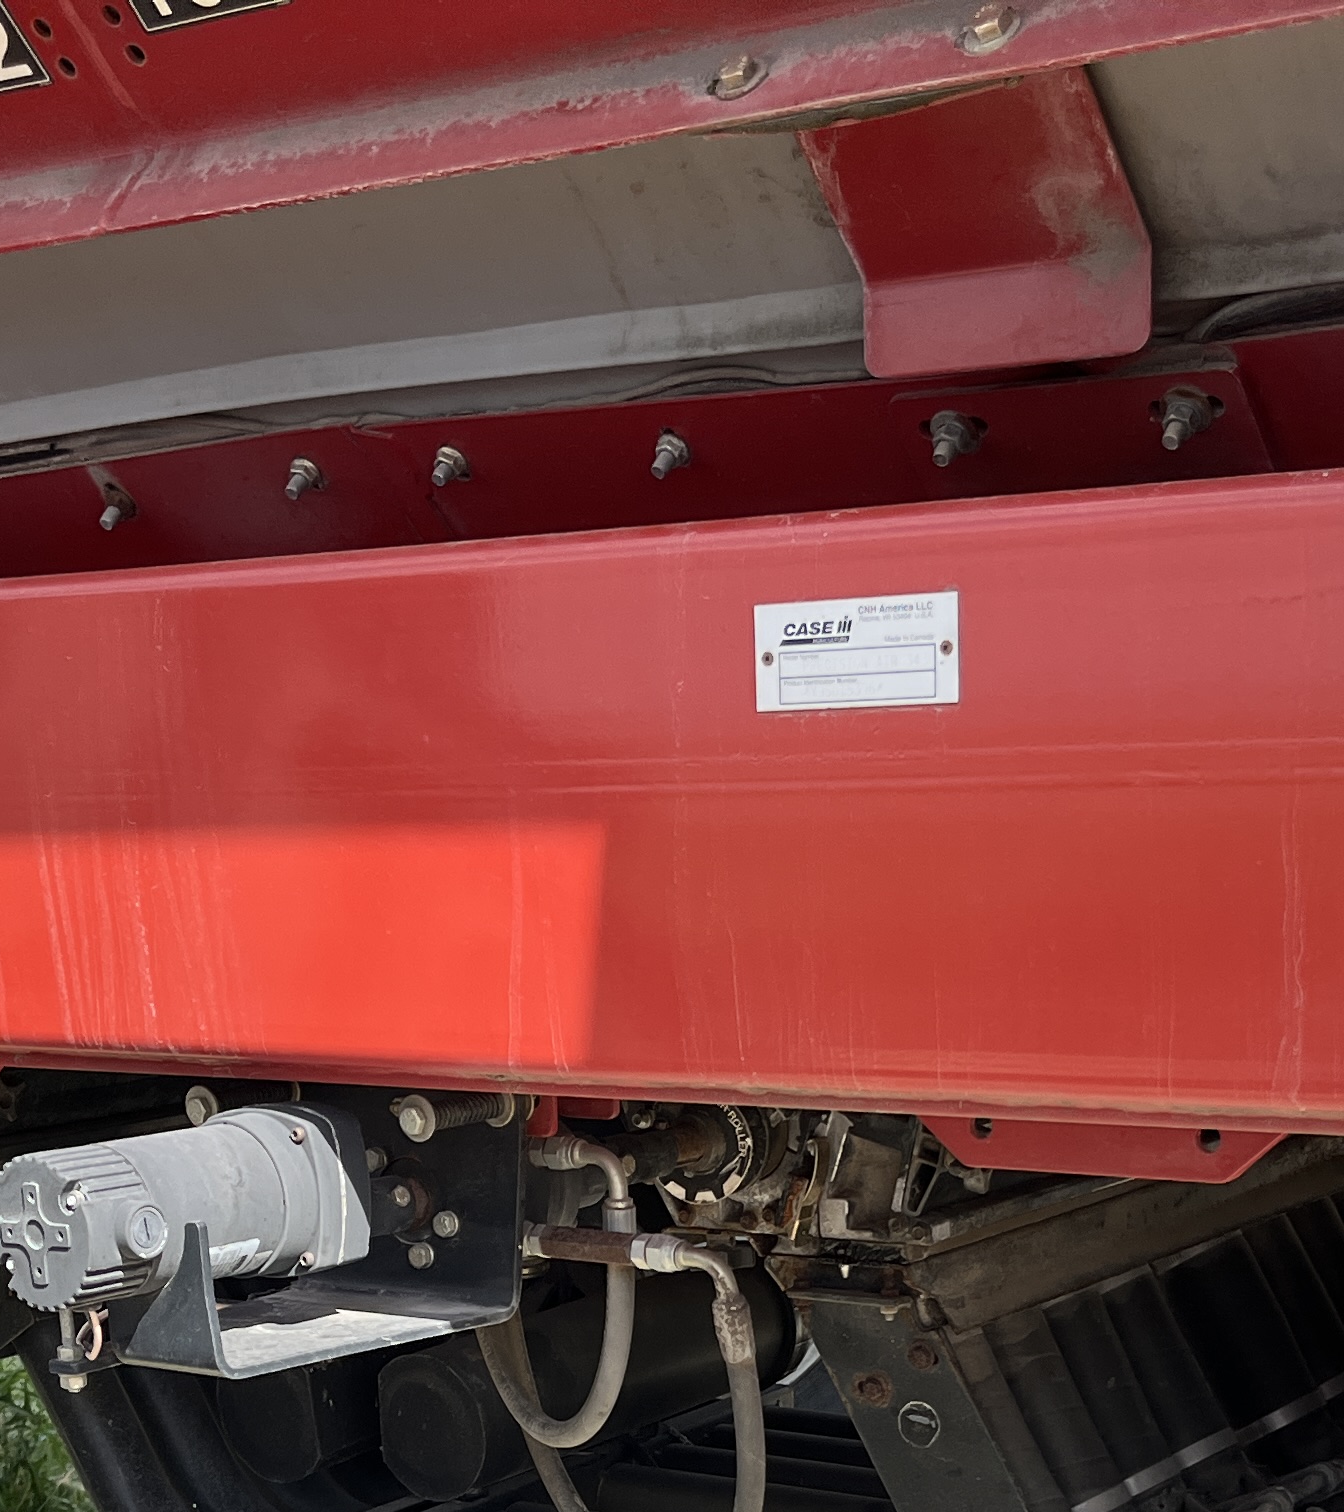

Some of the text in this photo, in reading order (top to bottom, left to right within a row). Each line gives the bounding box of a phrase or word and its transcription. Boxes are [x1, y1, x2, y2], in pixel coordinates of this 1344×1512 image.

[858, 601, 934, 614] CNH America LLC
[783, 621, 834, 636] CASE
[728, 1110, 749, 1157] ROLLER
